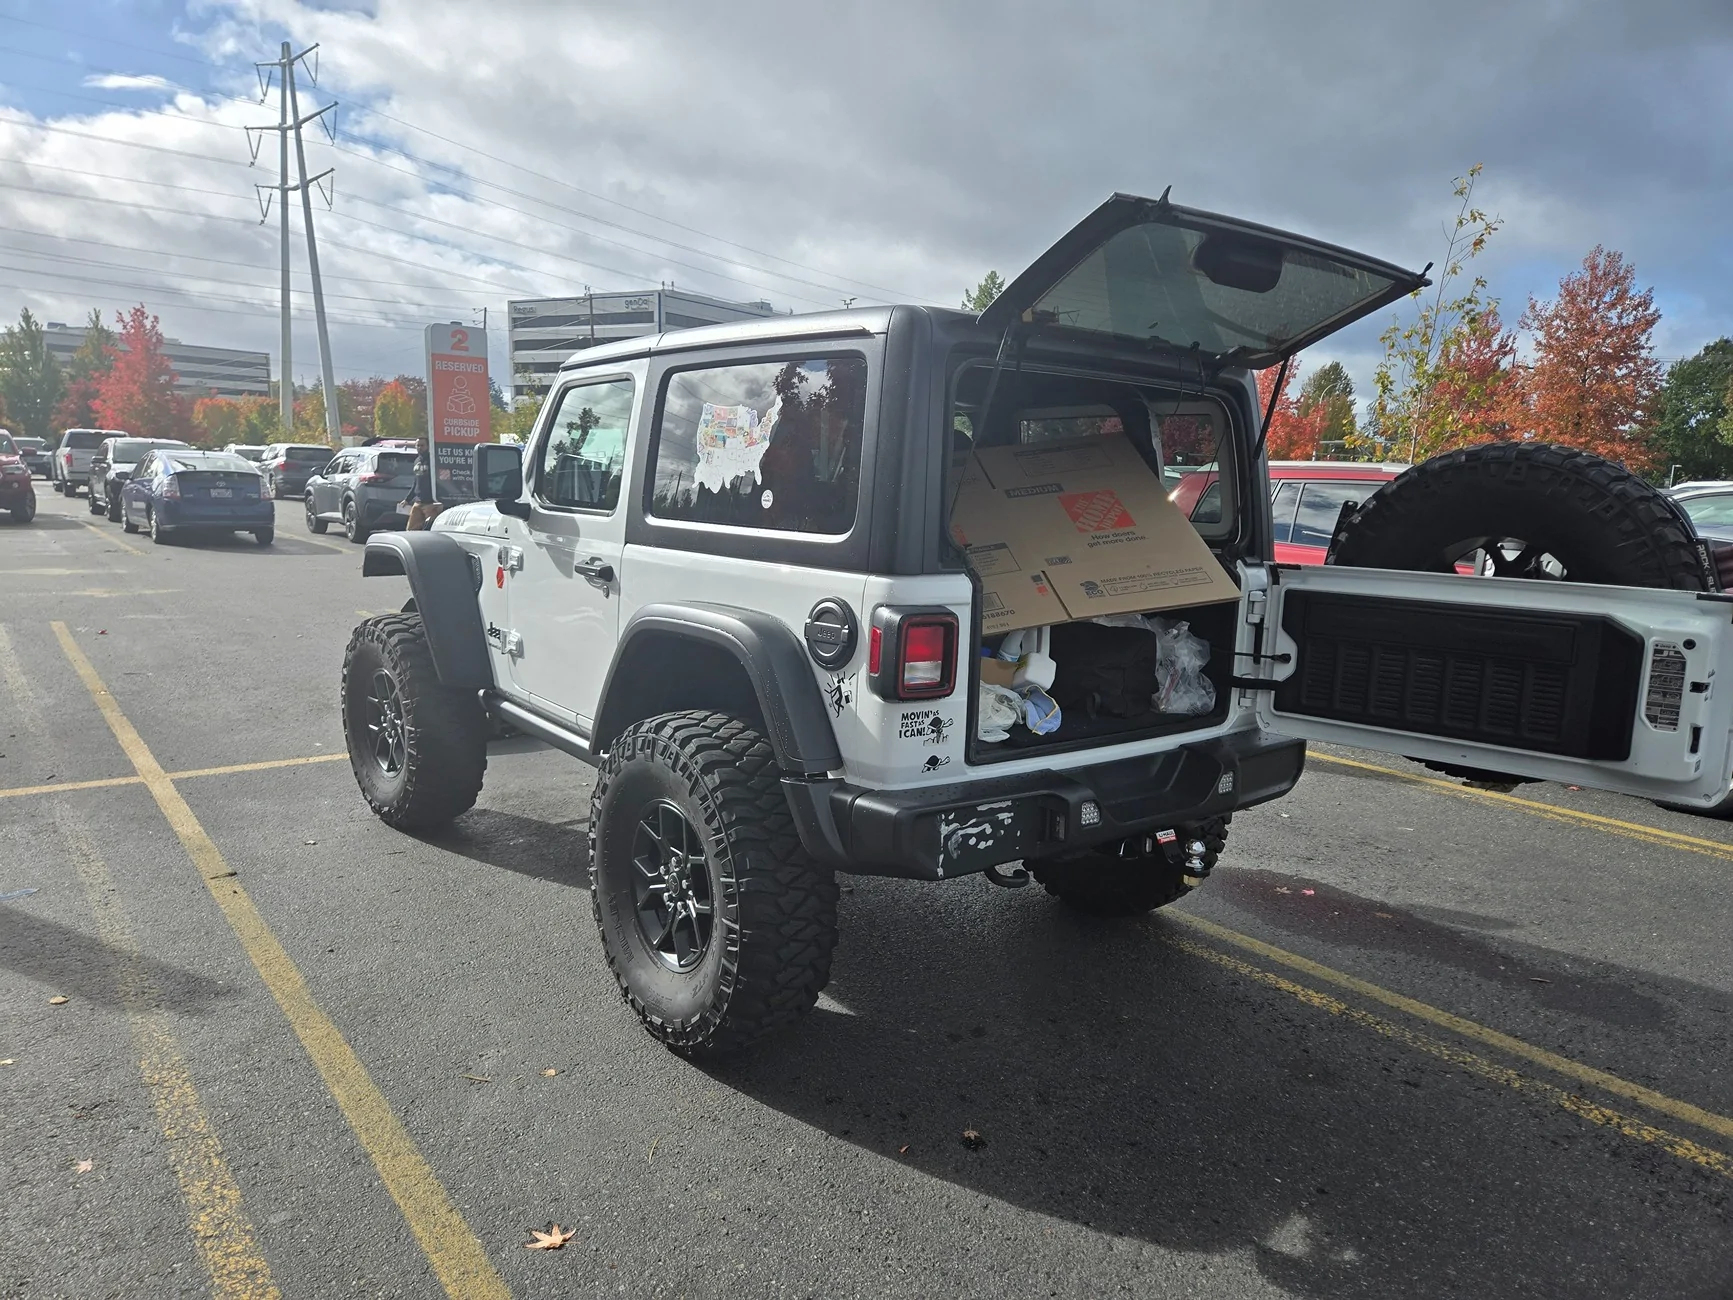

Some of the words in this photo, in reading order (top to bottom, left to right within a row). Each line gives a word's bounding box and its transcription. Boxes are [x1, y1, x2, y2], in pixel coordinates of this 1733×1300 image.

[451, 329, 469, 351] 2
[435, 360, 484, 373] RESERVED
[444, 418, 480, 427] CURBSIDE
[444, 427, 480, 437] PICKUP
[438, 448, 452, 456] LET
[453, 448, 464, 456] US
[439, 456, 466, 464] YOU'RE
[1009, 484, 1059, 497] MEDIUM
[1076, 493, 1117, 532] HOME
[1090, 533, 1110, 541] How
[1111, 530, 1136, 539] doers
[1087, 540, 1101, 549] get
[1102, 537, 1124, 545] more
[1696, 544, 1710, 569] ROCK
[1118, 574, 1136, 582] FROM
[1152, 568, 1185, 577] RECYCLED
[1085, 589, 1104, 597] ECO
[901, 710, 932, 721] MOVIN'
[901, 720, 918, 729] FAST
[899, 730, 902, 738] I
[903, 727, 926, 738] CAN!
